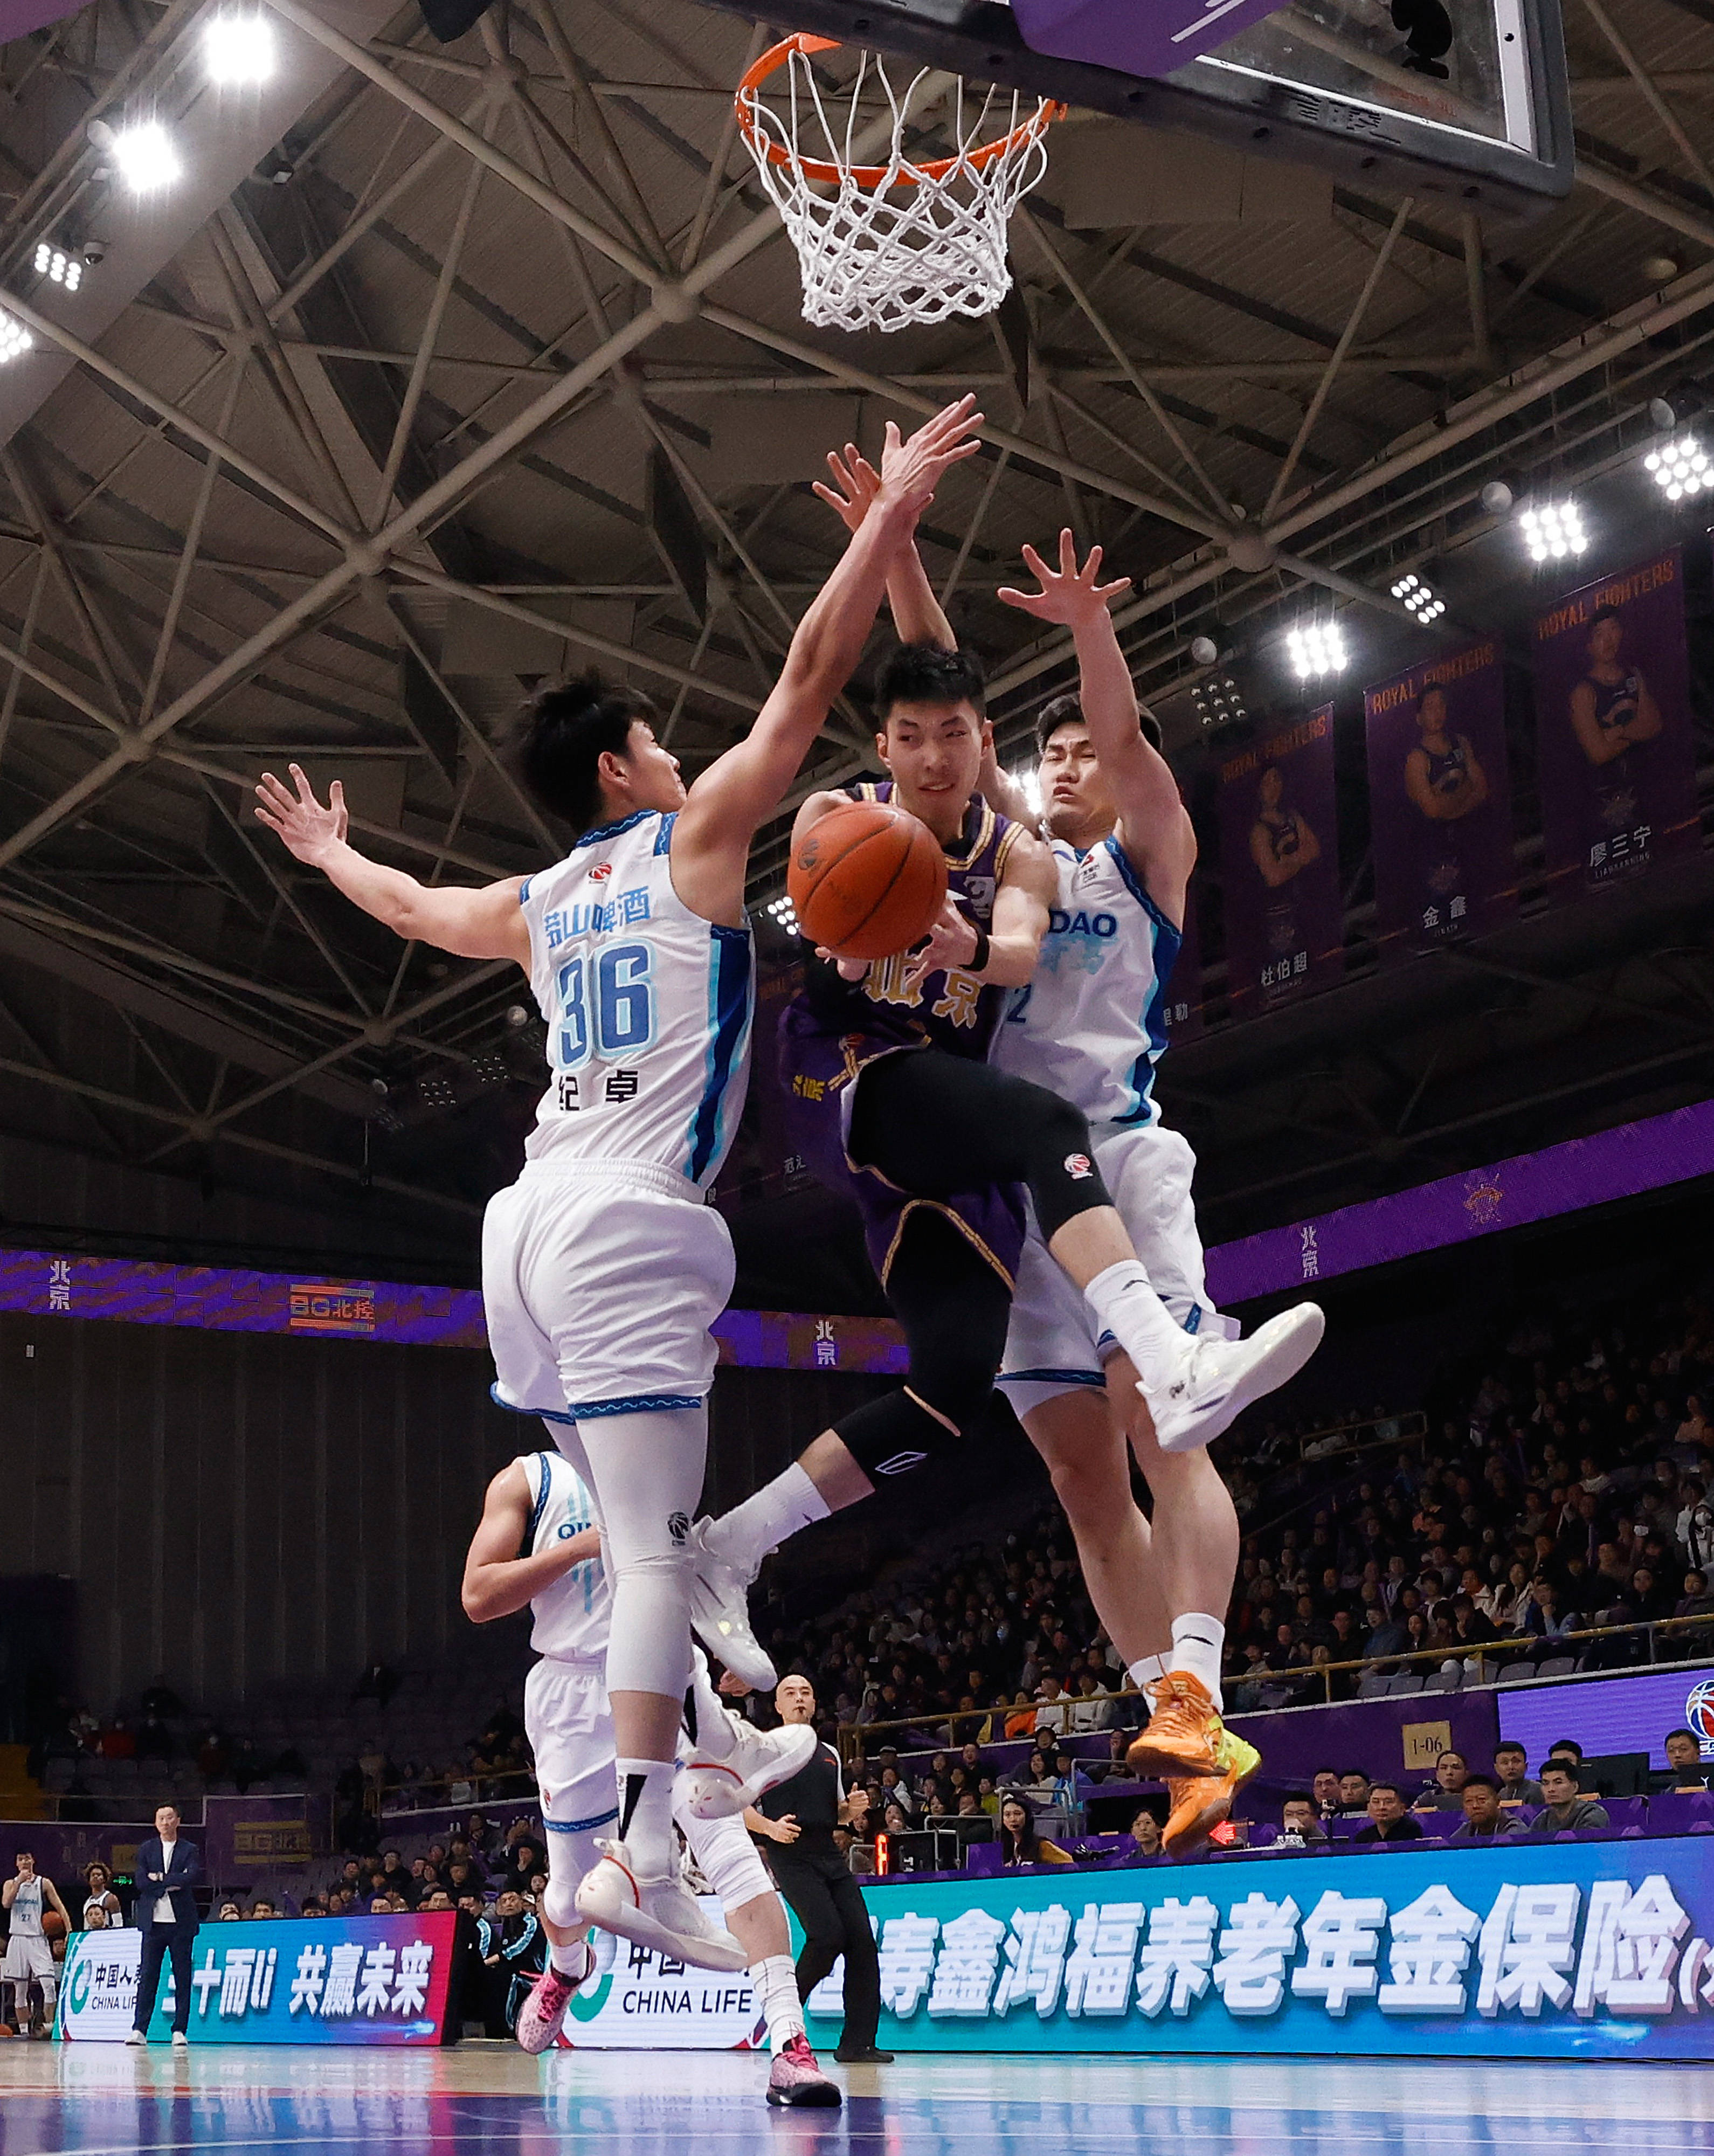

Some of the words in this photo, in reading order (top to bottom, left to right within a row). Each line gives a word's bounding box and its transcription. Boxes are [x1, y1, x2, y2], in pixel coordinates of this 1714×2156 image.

[1589, 825, 1652, 867] 廖三宁
[1422, 896, 1467, 929] 金鑫
[557, 939, 656, 1070] 36
[559, 1069, 638, 1111] 纪卓
[1301, 1226, 1319, 1278] 北京
[49, 1260, 71, 1310] 北京
[814, 1319, 836, 1366] 北京
[1413, 1736, 1443, 1755] 1-06
[808, 1874, 1714, 2019] 寿鑫鸿福养老年金保险(
[289, 1939, 433, 2018] 共赢未来
[91, 1996, 120, 2010] CHINA
[122, 1995, 138, 2009] LIF
[623, 1990, 692, 2014] CHINA
[701, 1989, 754, 2014] LIFE
